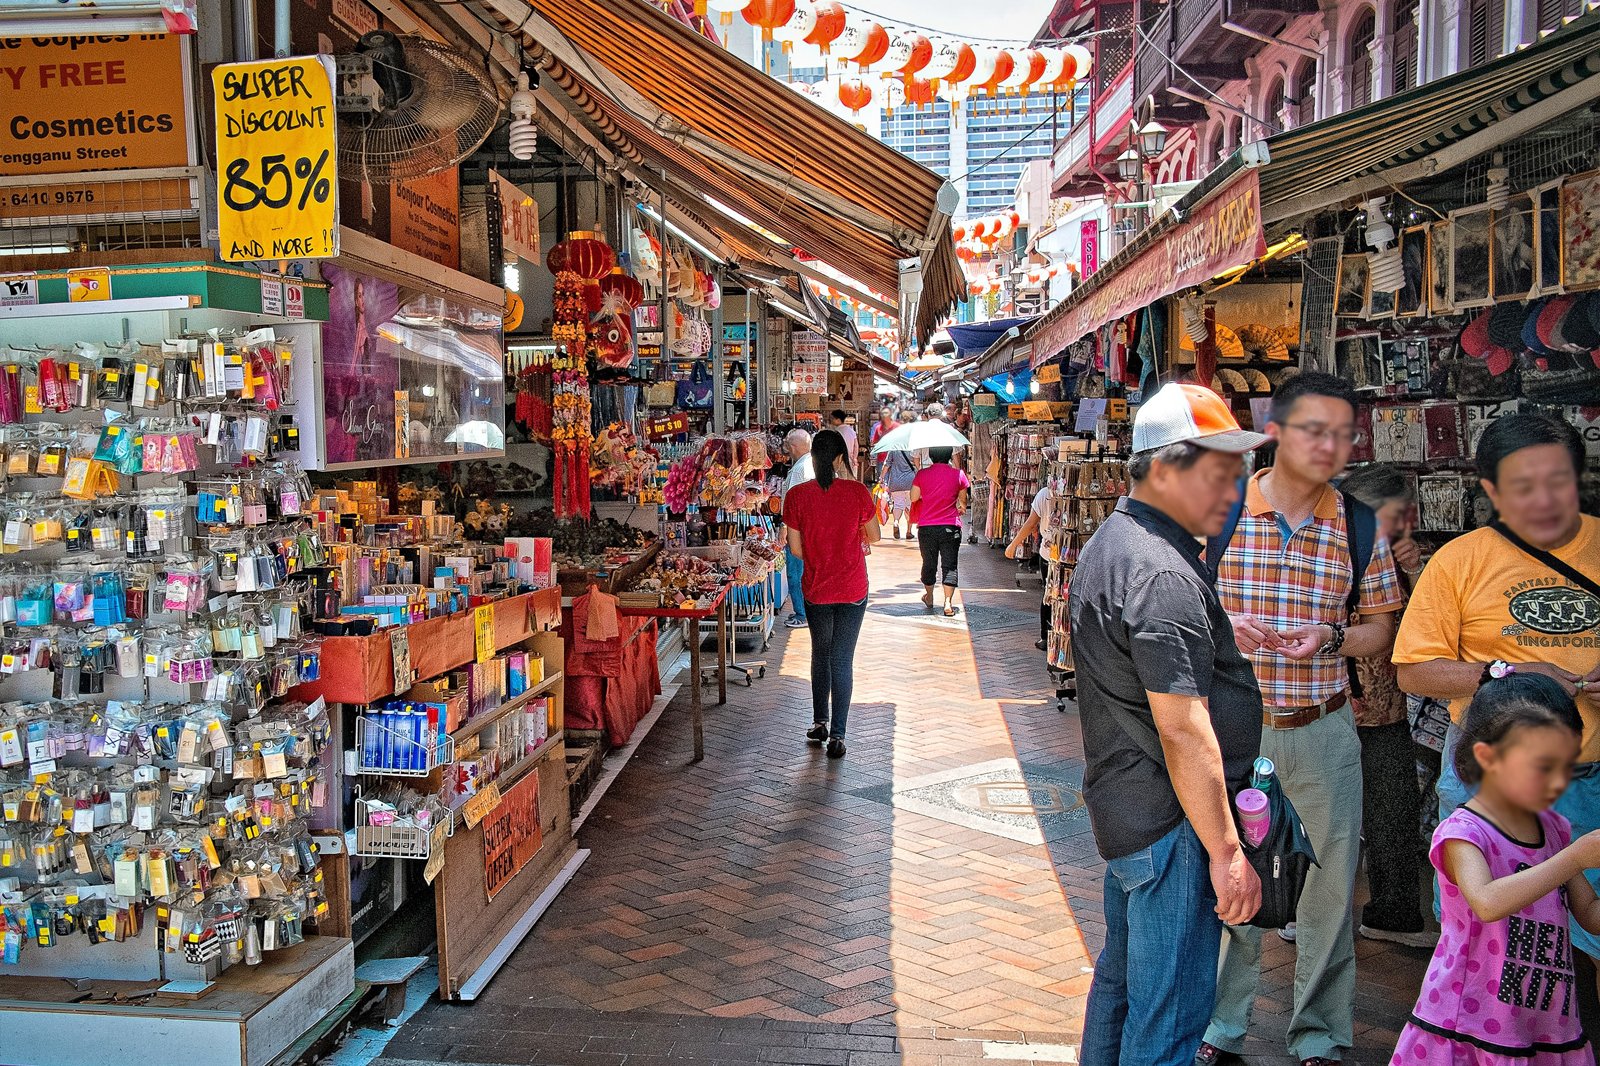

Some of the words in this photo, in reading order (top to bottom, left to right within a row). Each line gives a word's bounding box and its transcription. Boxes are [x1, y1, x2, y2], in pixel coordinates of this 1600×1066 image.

[39, 60, 126, 88] FREE
[223, 65, 312, 101] SUPER
[10, 110, 173, 140] Cosmetics
[76, 146, 127, 160] Street
[224, 149, 329, 211] 85%
[11, 193, 48, 206] 6410
[55, 190, 94, 204] 9676
[230, 240, 264, 258] AND
[273, 237, 313, 257] MORE
[654, 425, 665, 433] for
[1503, 577, 1558, 599] FANTASY
[1516, 636, 1600, 648] SINGAPORE
[485, 813, 512, 856] SUPER
[368, 841, 415, 851] lenovo
[486, 845, 514, 891] OFFER
